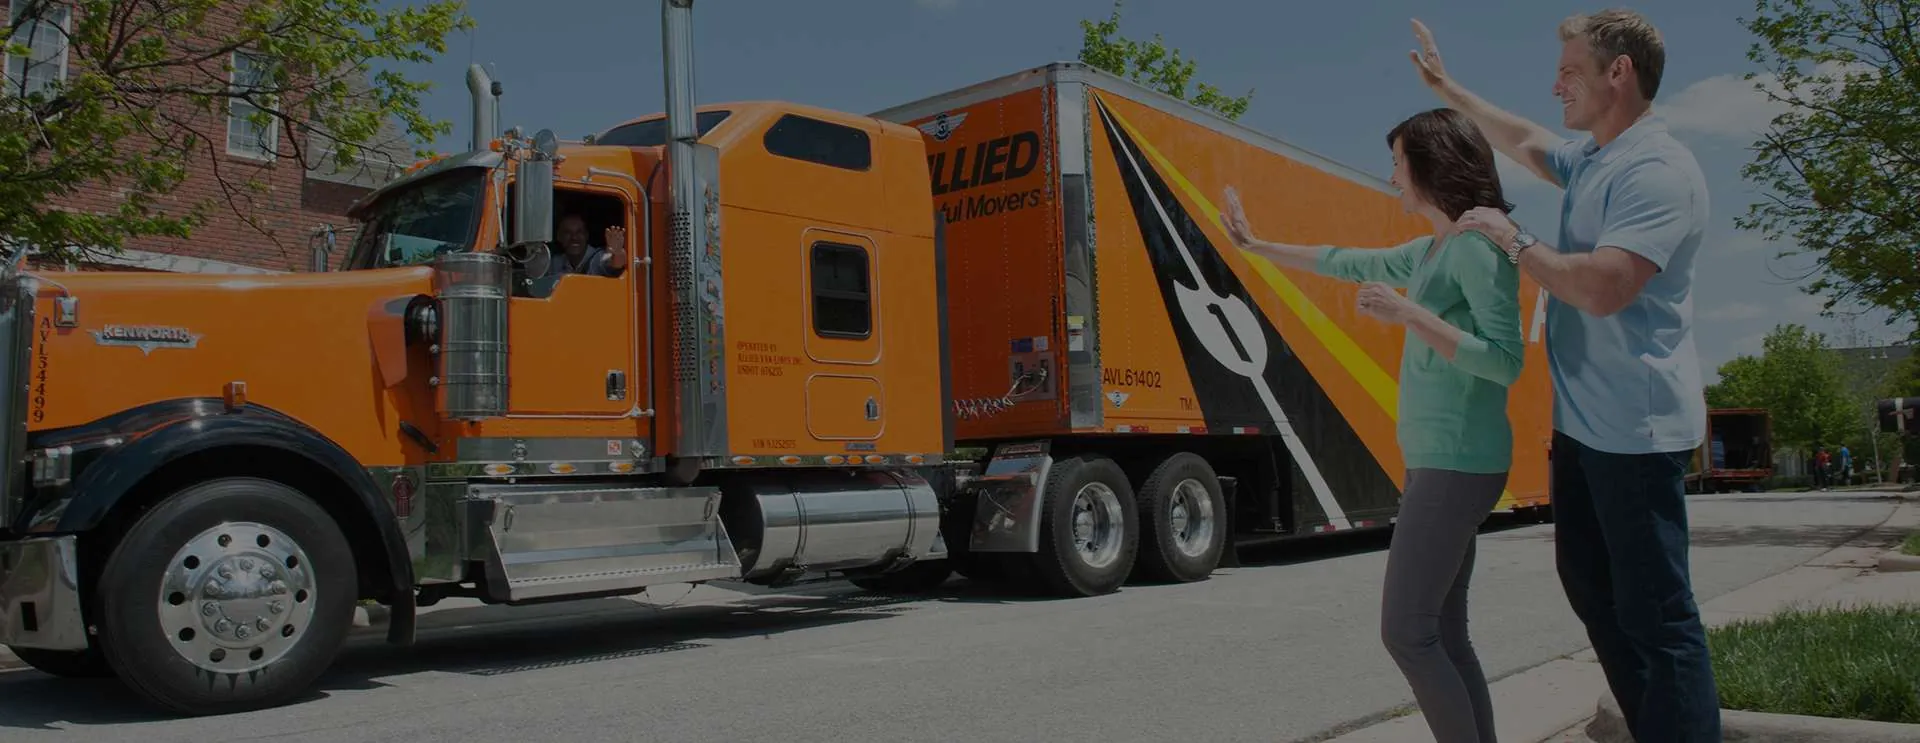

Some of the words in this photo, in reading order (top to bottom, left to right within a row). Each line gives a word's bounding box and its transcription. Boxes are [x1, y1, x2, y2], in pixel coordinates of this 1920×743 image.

[927, 130, 1040, 195] LLIED
[966, 188, 1041, 219] Movers
[103, 324, 190, 342] KENWORTH
[1103, 367, 1162, 388] AVL61402
[1179, 397, 1192, 410] TM
